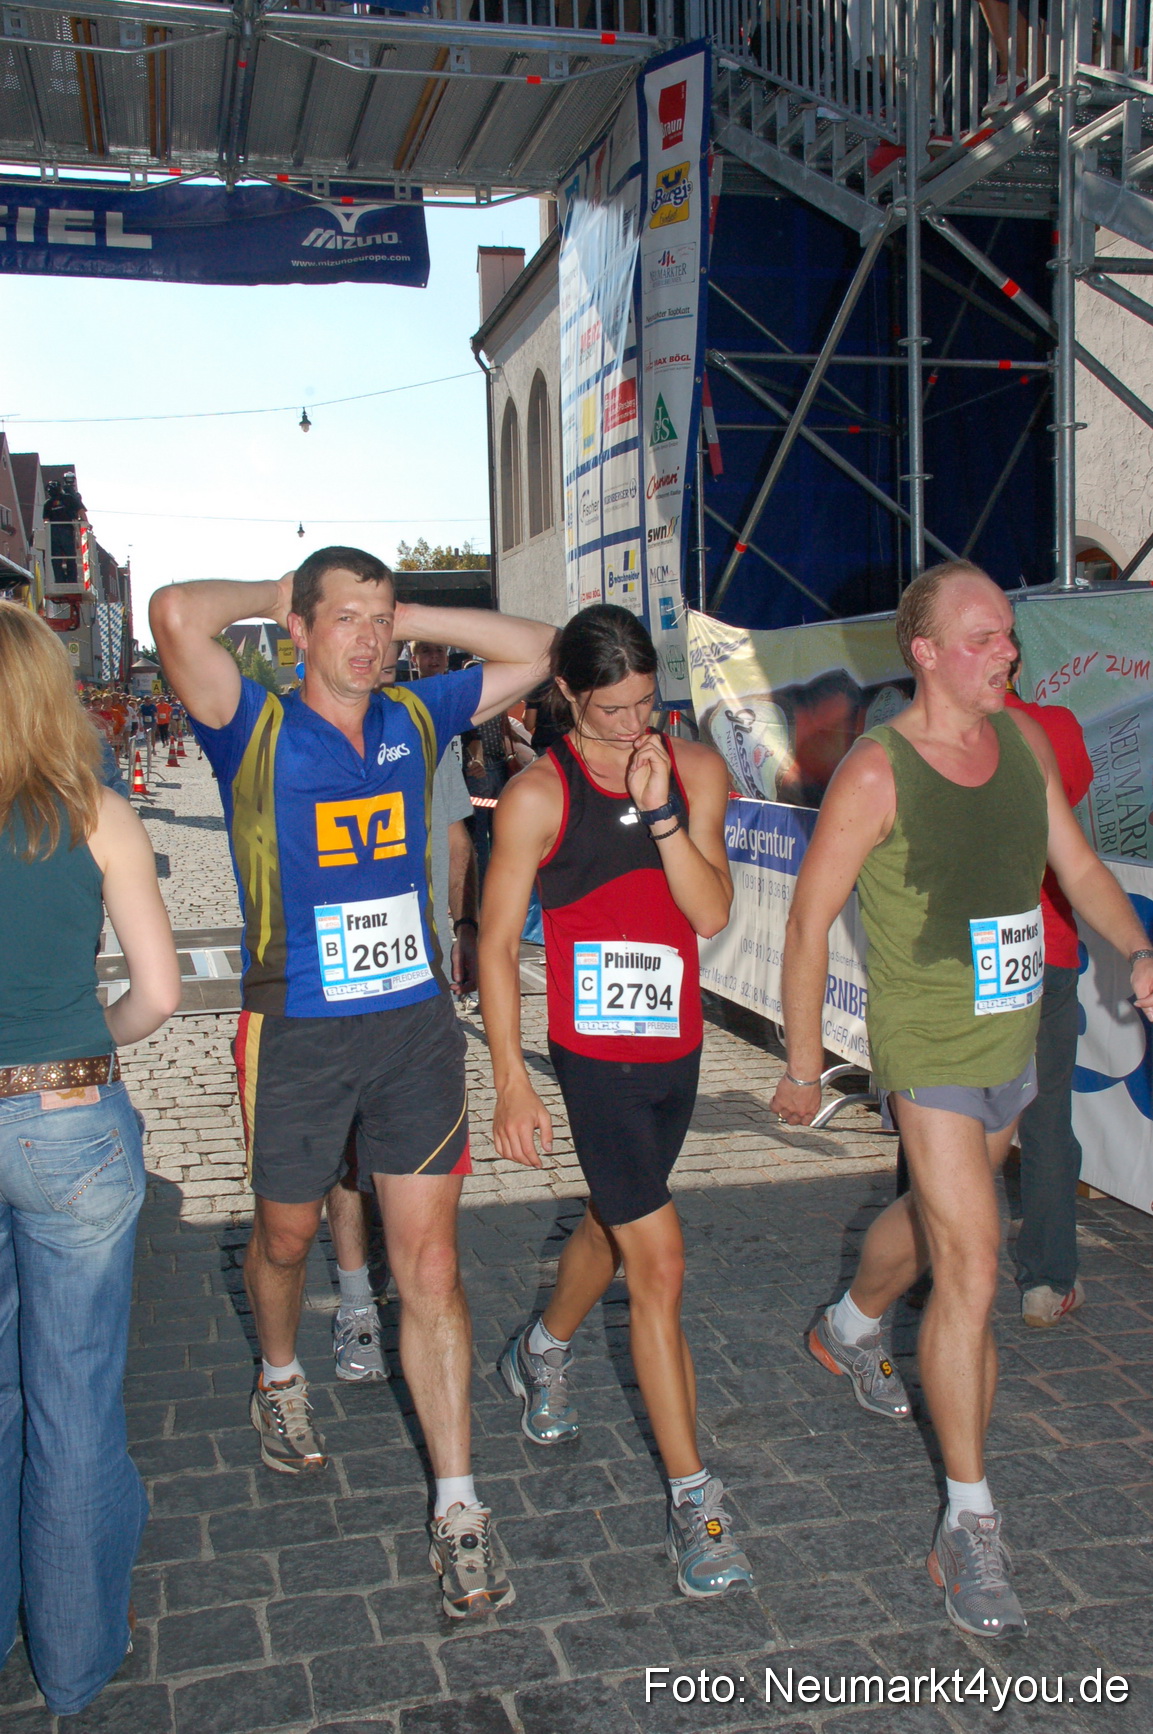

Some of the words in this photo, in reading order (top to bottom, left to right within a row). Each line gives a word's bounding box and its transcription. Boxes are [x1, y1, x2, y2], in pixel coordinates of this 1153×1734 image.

[291, 253, 411, 267] www.mizunoeurope.com
[669, 353, 691, 363] BÖGL
[1106, 654, 1151, 680] zum
[346, 912, 388, 931] Franz
[326, 942, 338, 957] B
[352, 934, 418, 971] 2618
[981, 956, 992, 970] C
[581, 976, 594, 991] C
[606, 983, 673, 1010] 2794
